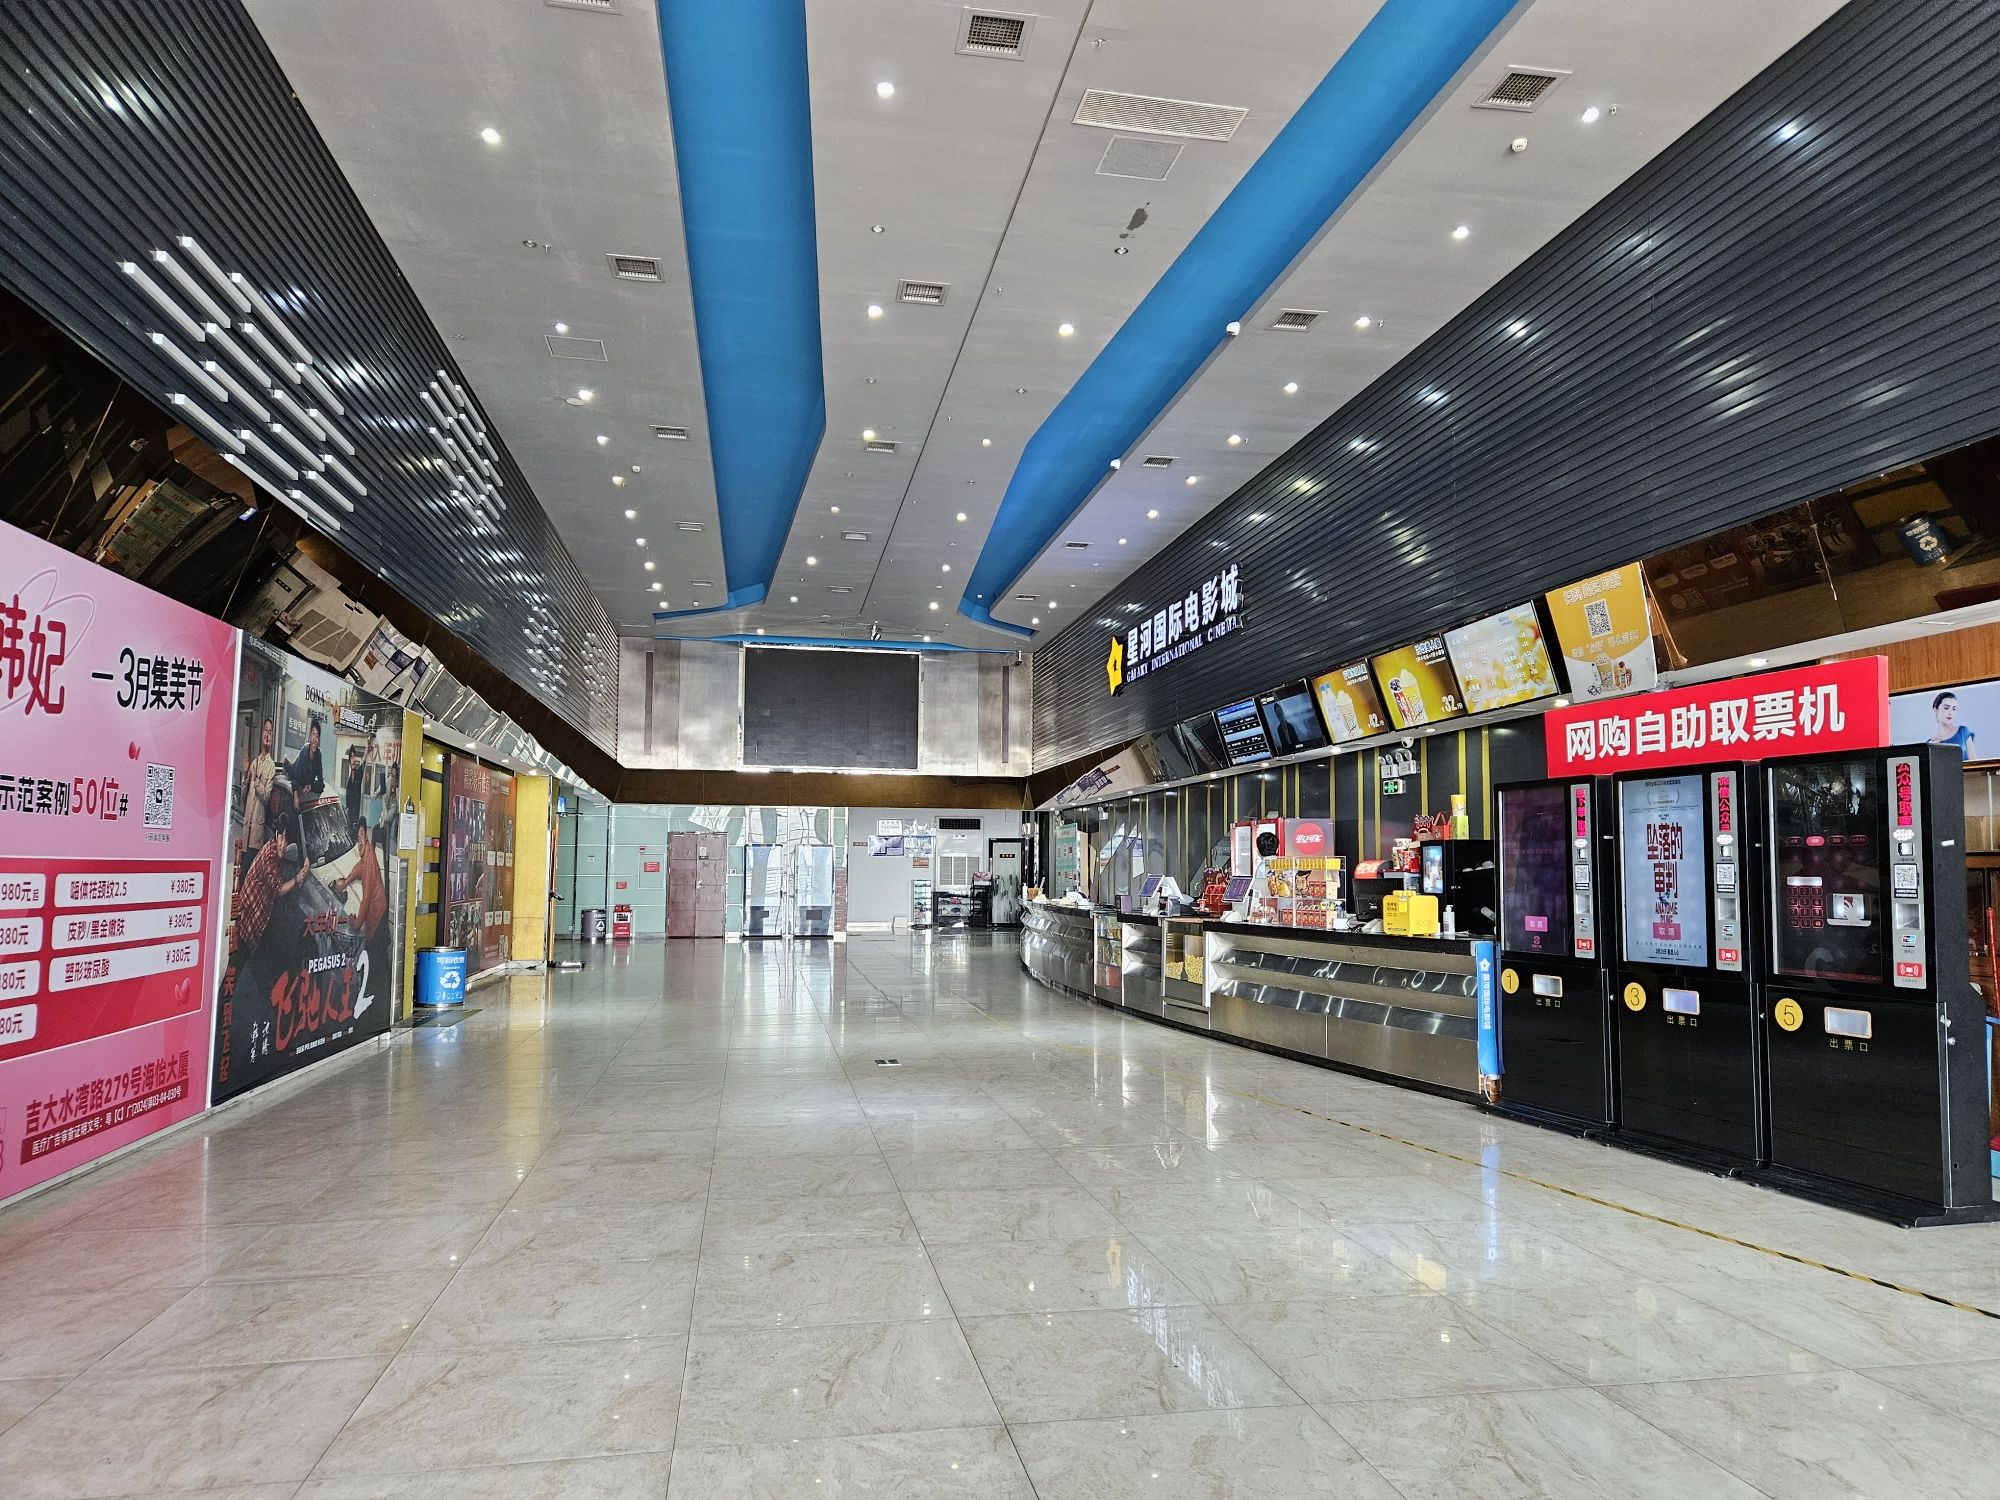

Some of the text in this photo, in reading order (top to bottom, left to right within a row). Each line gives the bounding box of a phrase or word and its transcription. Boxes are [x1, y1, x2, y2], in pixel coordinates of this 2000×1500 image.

[1126, 563, 1239, 667] 星河国际电影城
[1126, 614, 1237, 683] GALAXY INTERNATIONAL CINEMA
[1565, 684, 1846, 763] 网购自助取票机
[1646, 822, 1684, 860] 坠落的
[1653, 859, 1678, 899] 审判
[65, 958, 110, 983] 塑形玻尿酸
[308, 953, 346, 974] PEGASUS 2
[0, 969, 26, 990] 80元
[1506, 973, 1512, 991] 1
[1630, 987, 1640, 1007] 3
[1666, 1014, 1698, 1028] 出票口
[1783, 1004, 1796, 1027] 5
[1829, 1037, 1869, 1053] 出票口
[25, 1050, 190, 1136] 吉大水湾路279号海怡大厦
